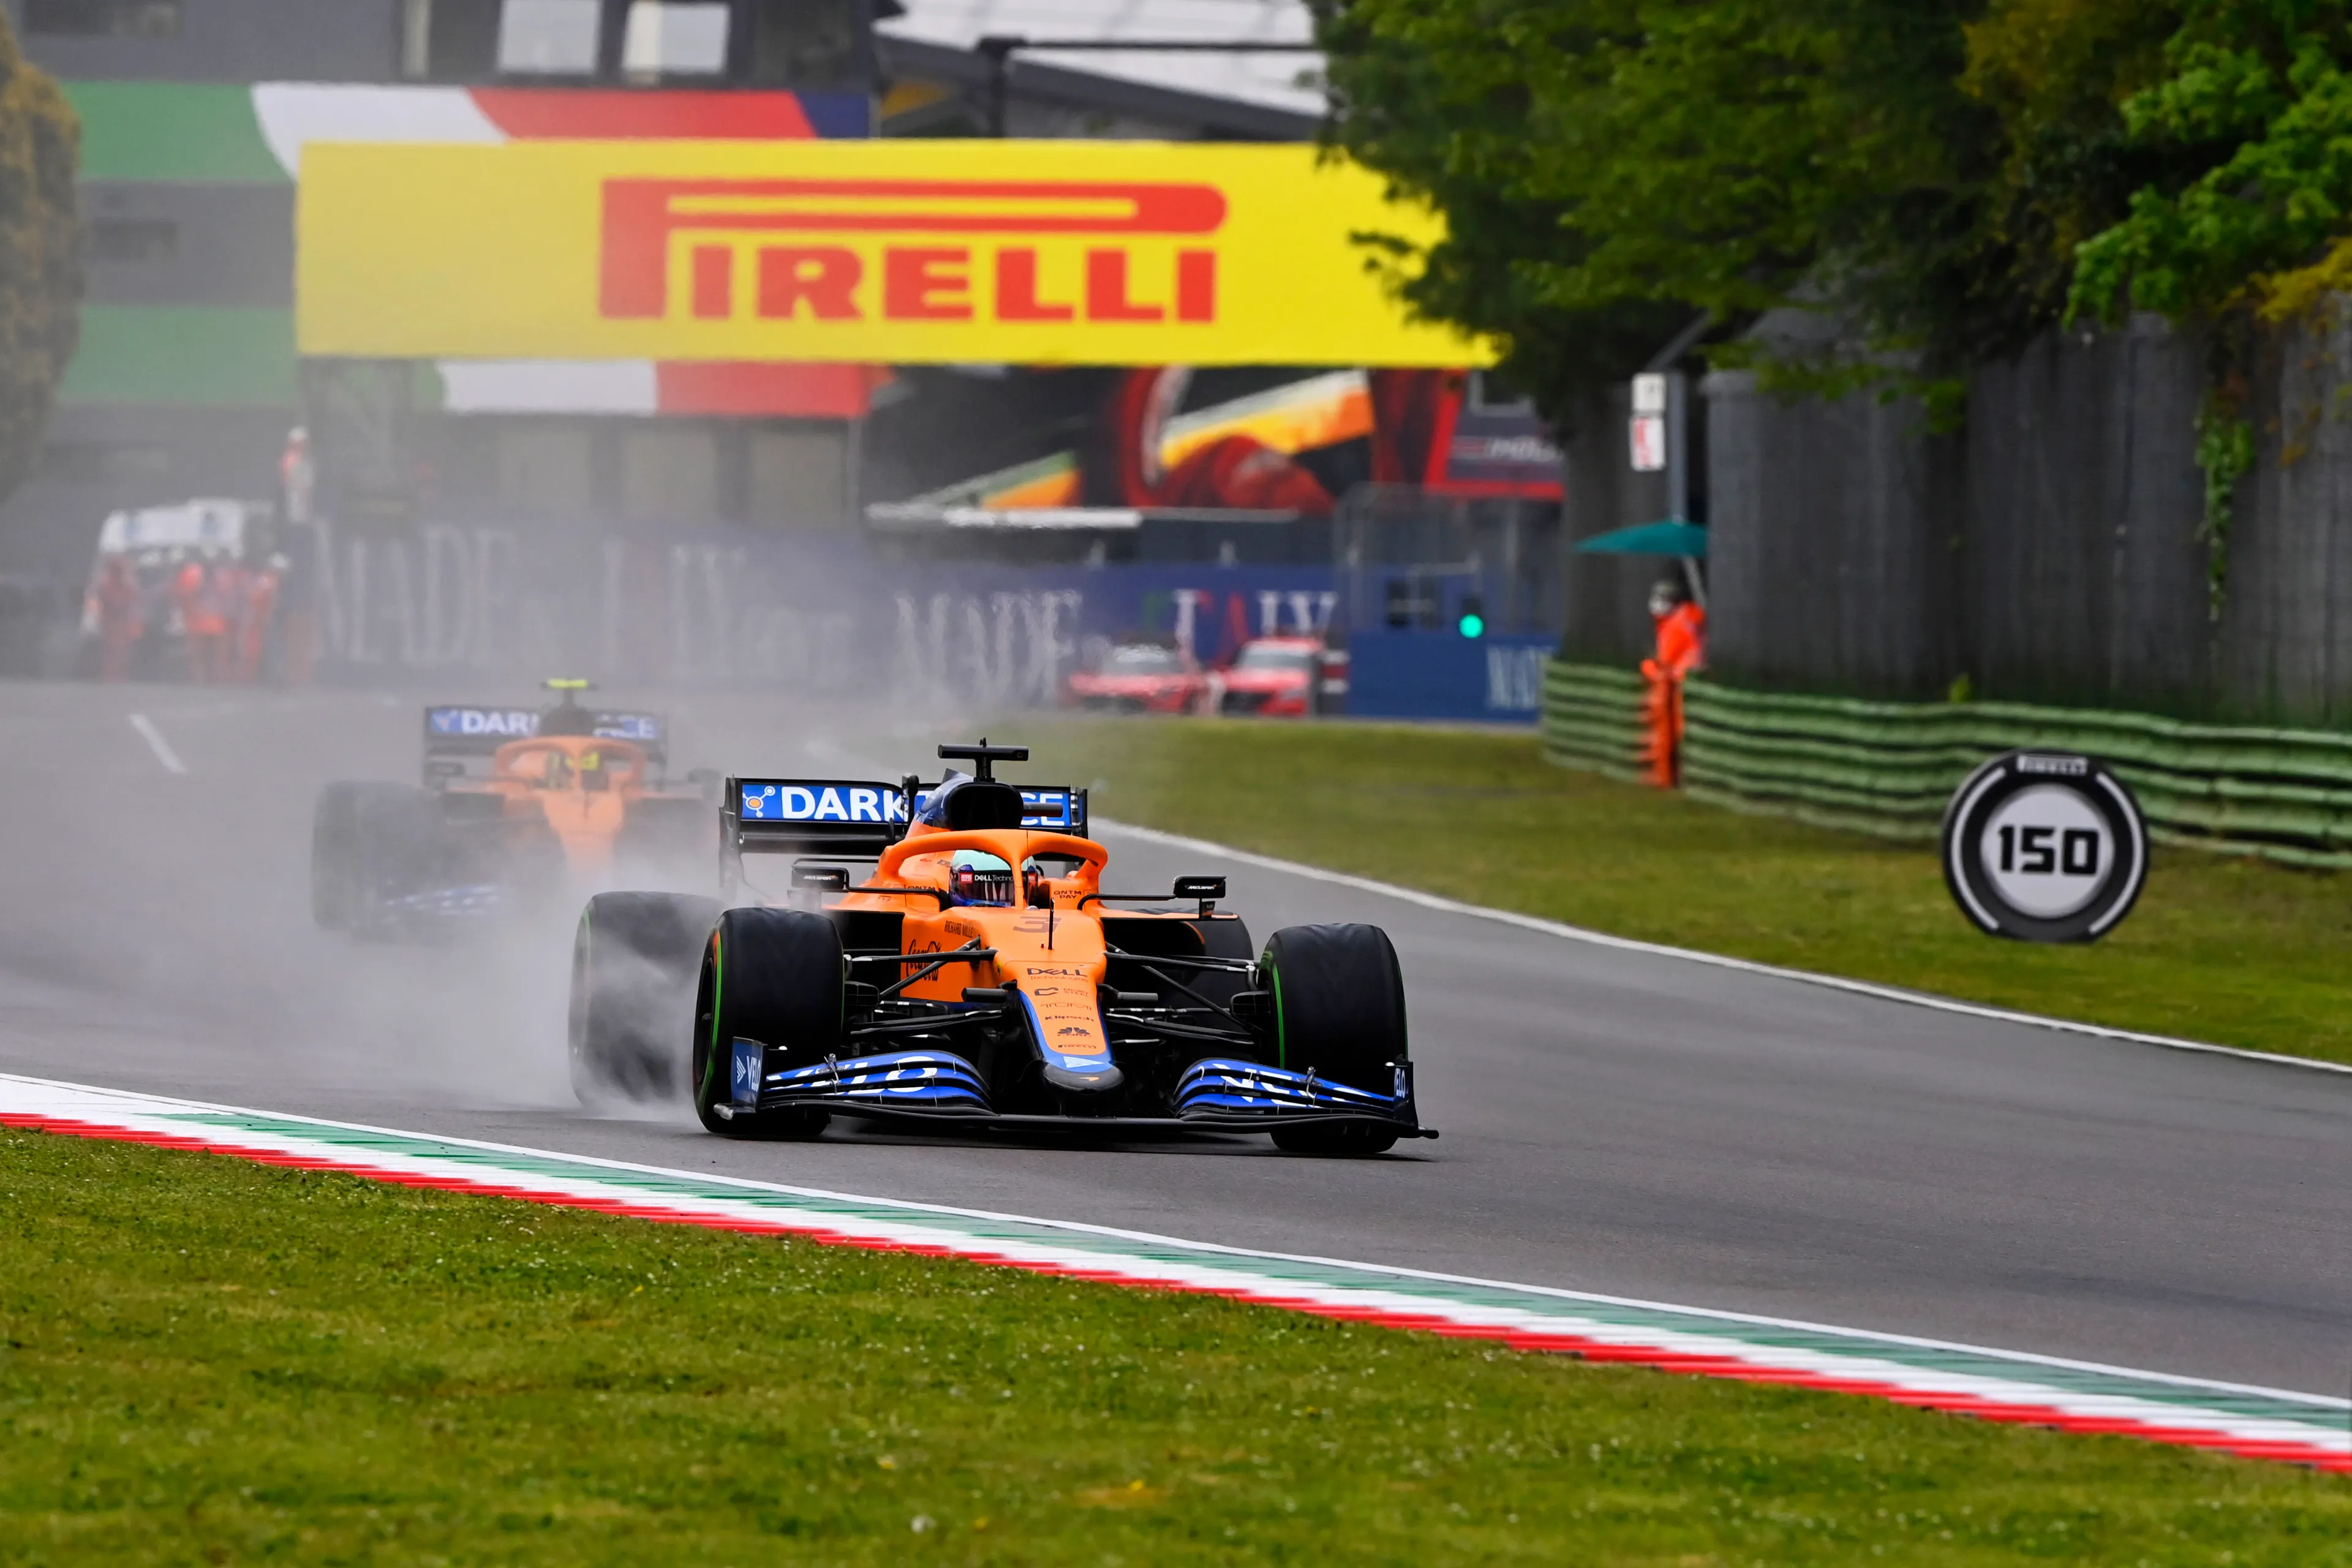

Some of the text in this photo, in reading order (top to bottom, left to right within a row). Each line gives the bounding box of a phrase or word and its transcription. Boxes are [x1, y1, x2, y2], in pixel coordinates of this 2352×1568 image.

[599, 178, 1227, 322] PIRELLI
[1999, 825, 2099, 876] 150
[1013, 916, 1062, 933] 3
[1027, 968, 1088, 977] DELL
